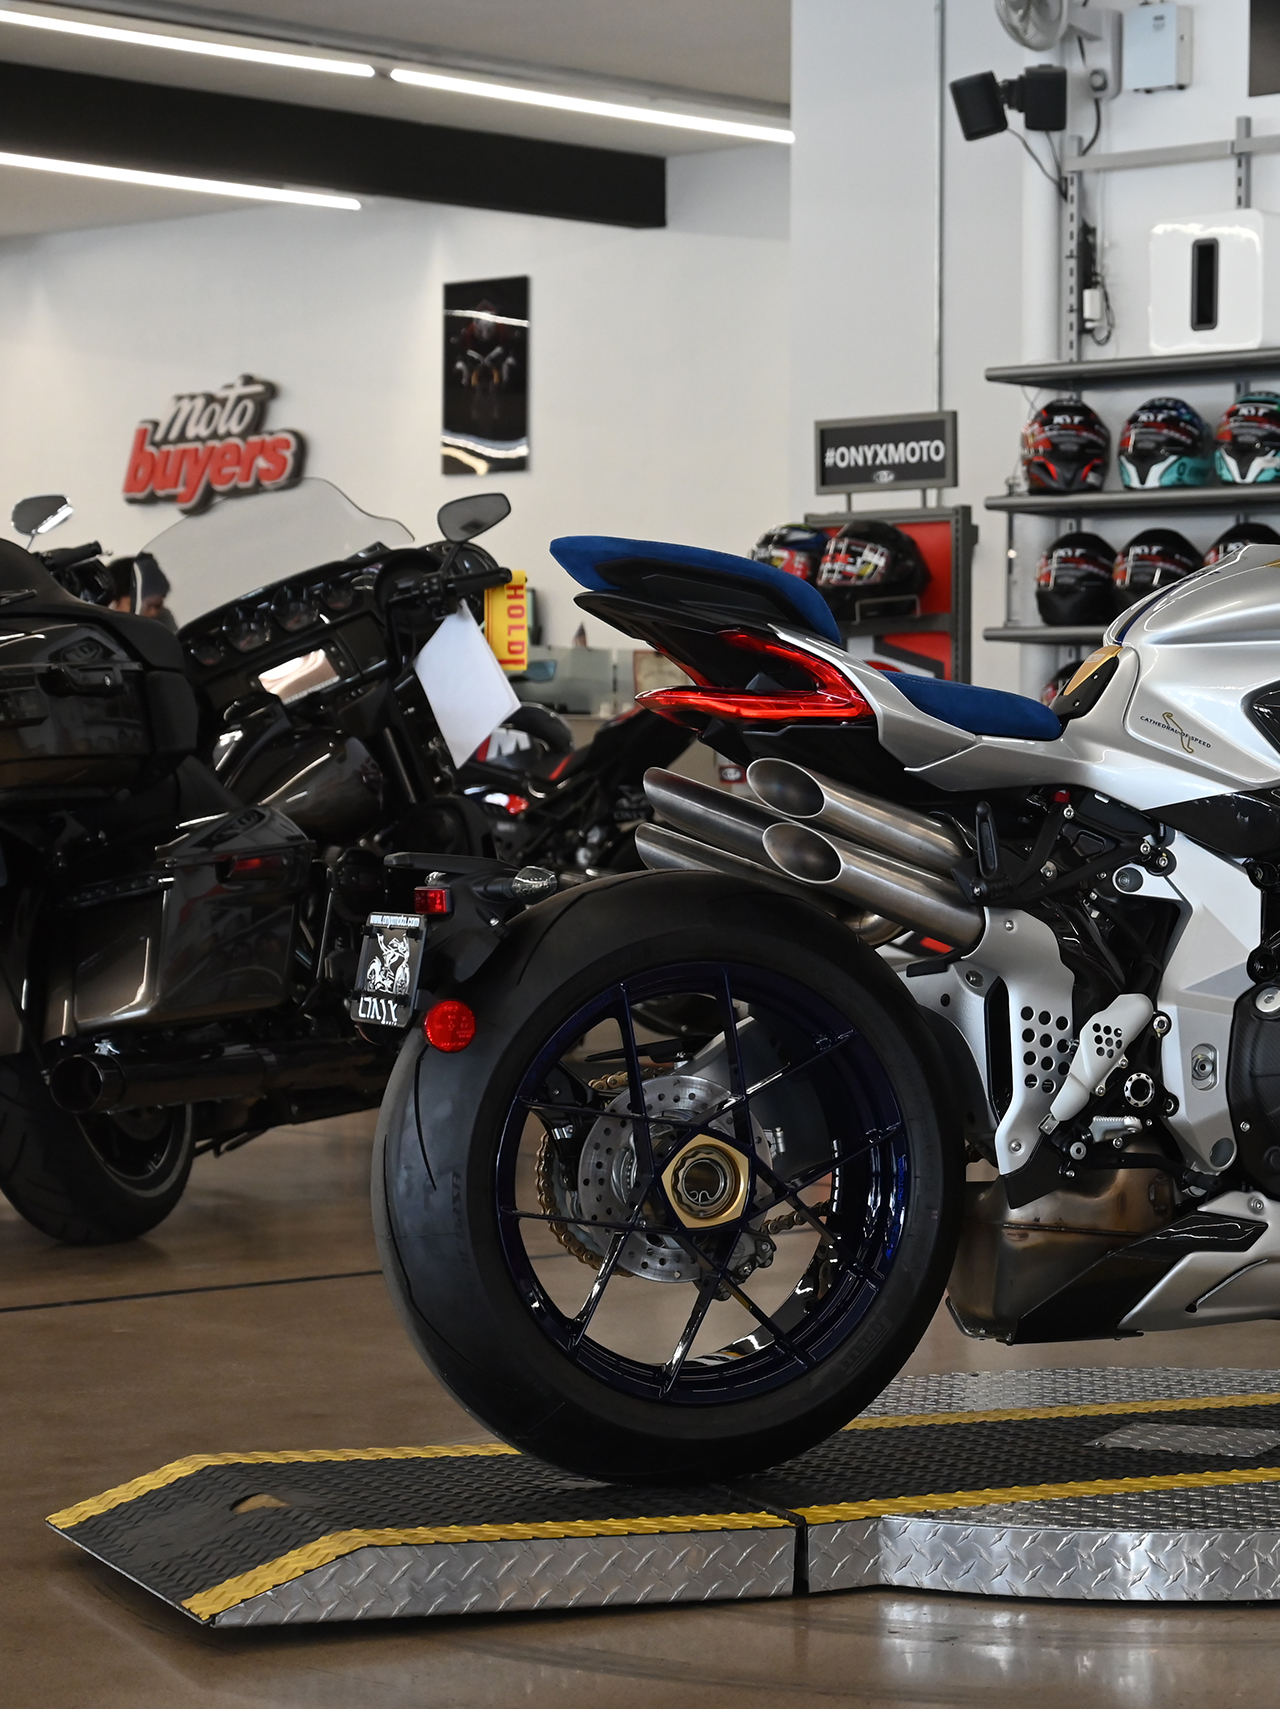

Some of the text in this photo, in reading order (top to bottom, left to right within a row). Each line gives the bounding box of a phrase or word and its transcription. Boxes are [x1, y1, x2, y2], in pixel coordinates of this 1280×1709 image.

[154, 377, 265, 442] Moto
[122, 424, 295, 506] buyers
[824, 439, 946, 469] #ONYXMOTO
[1140, 715, 1180, 735] CATHEDRAL
[1190, 735, 1212, 749] SPEED
